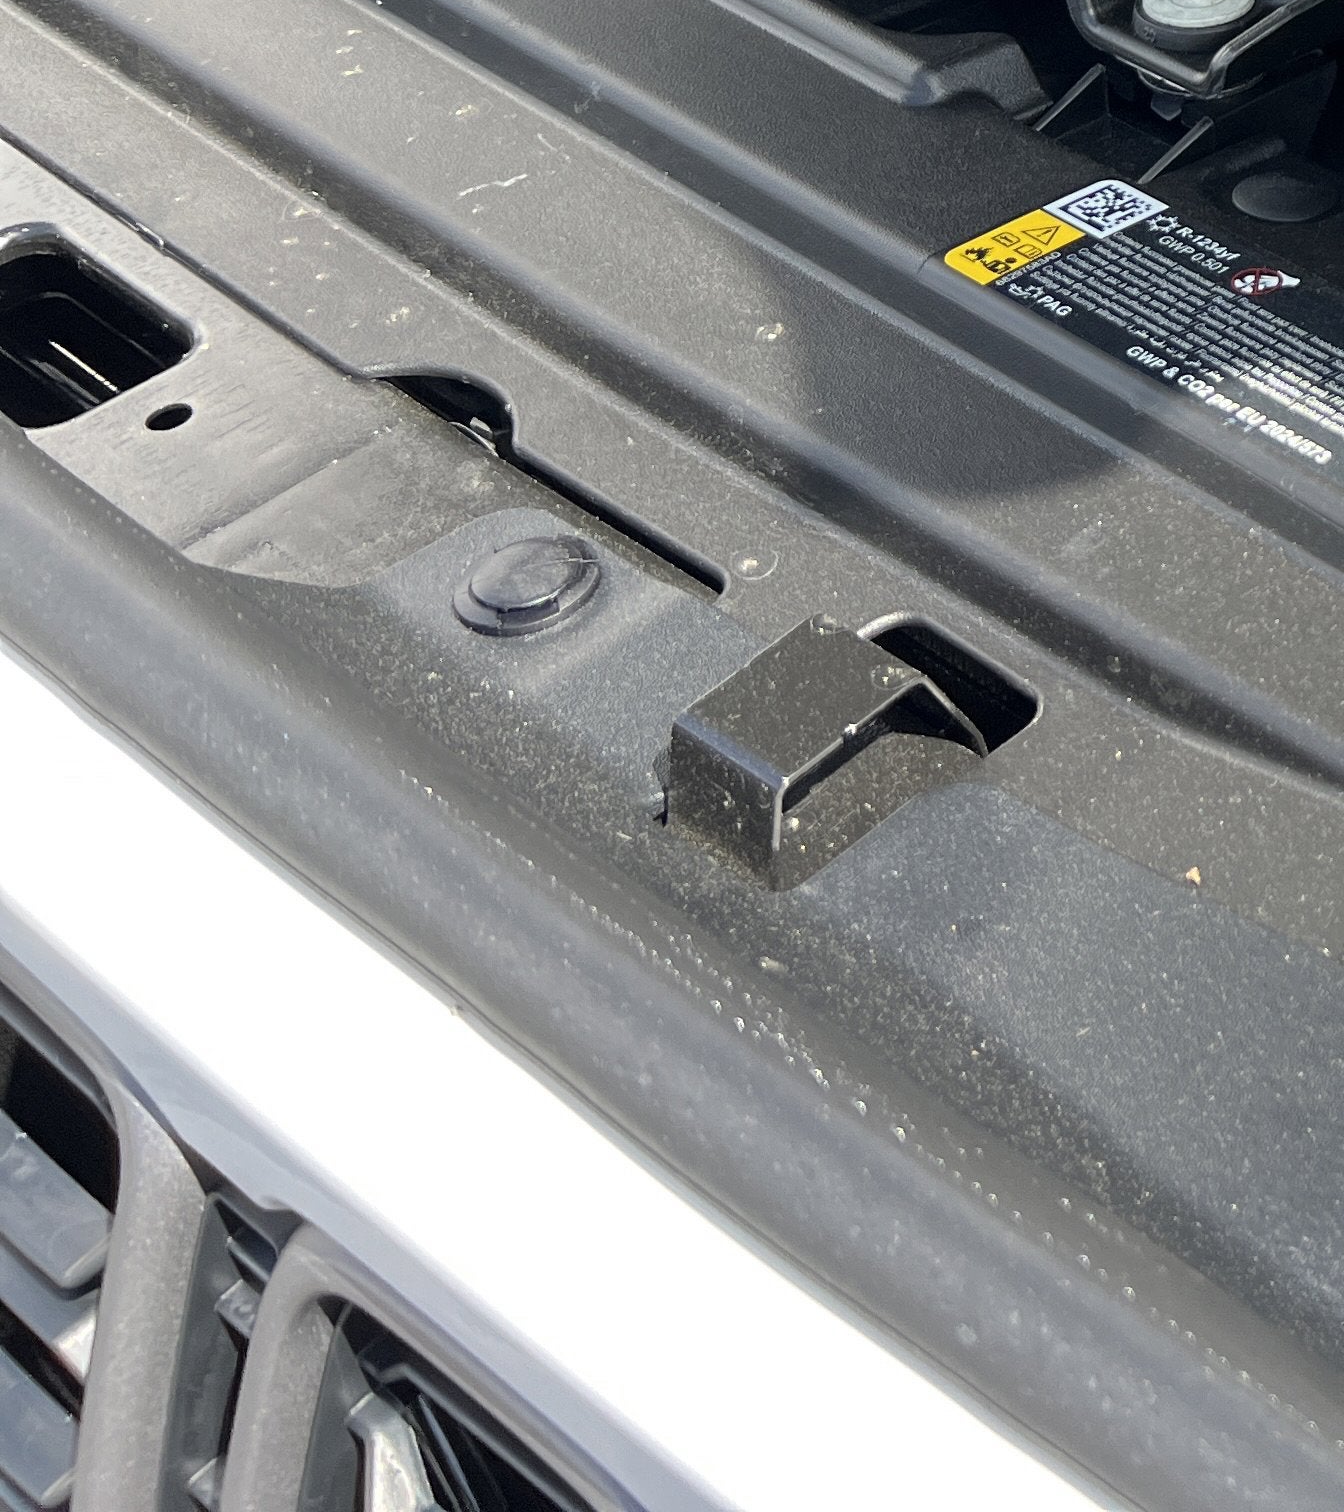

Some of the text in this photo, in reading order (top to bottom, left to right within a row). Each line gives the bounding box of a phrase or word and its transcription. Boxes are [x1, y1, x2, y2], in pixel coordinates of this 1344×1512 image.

[1159, 235, 1229, 273] GWP 0.501
[1176, 226, 1241, 261] R-1234yf
[1036, 295, 1073, 316] PAG
[1127, 345, 1168, 368] GWP
[1163, 365, 1179, 378] &
[1178, 373, 1215, 397] CO2
[1205, 393, 1238, 414] per
[1238, 406, 1266, 426] EU
